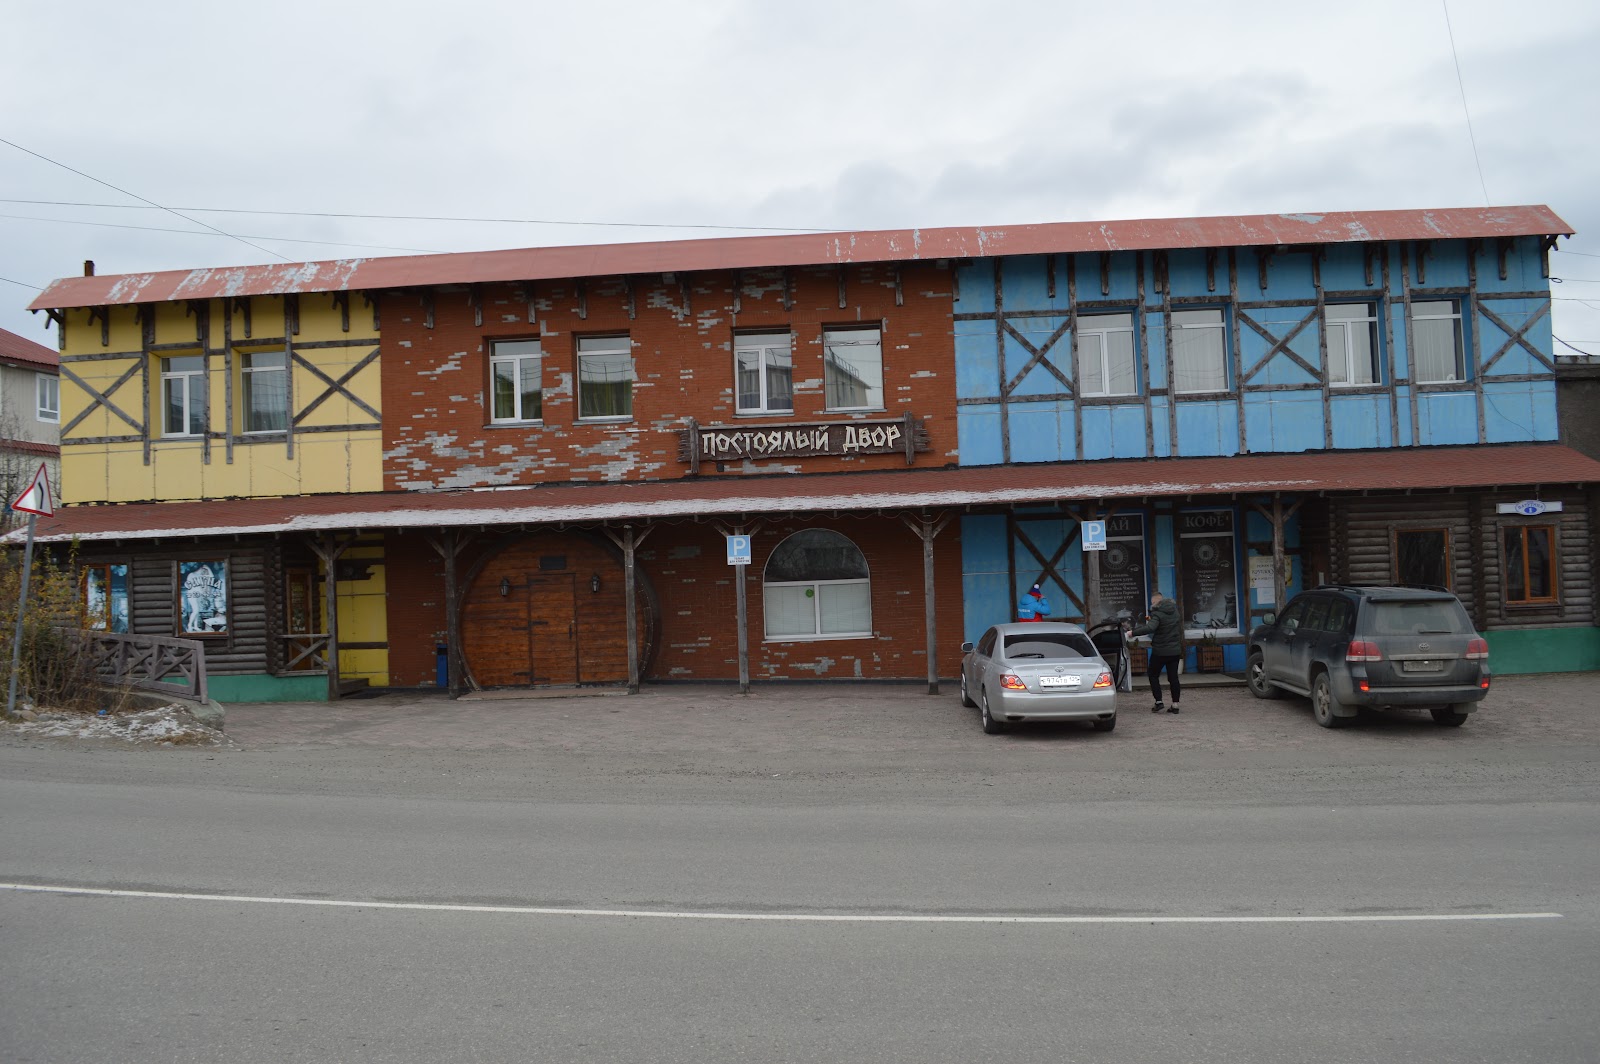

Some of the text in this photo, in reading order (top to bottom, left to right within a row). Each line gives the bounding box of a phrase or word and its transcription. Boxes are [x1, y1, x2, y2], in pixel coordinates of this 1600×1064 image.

[702, 425, 901, 460] ПОСТОЯЛЫЙ ДВОР
[1106, 517, 1129, 531] АЙ
[1185, 515, 1225, 528] КОФЕ
[1088, 522, 1102, 542] P
[733, 538, 746, 556] P
[184, 576, 222, 591] САУНА
